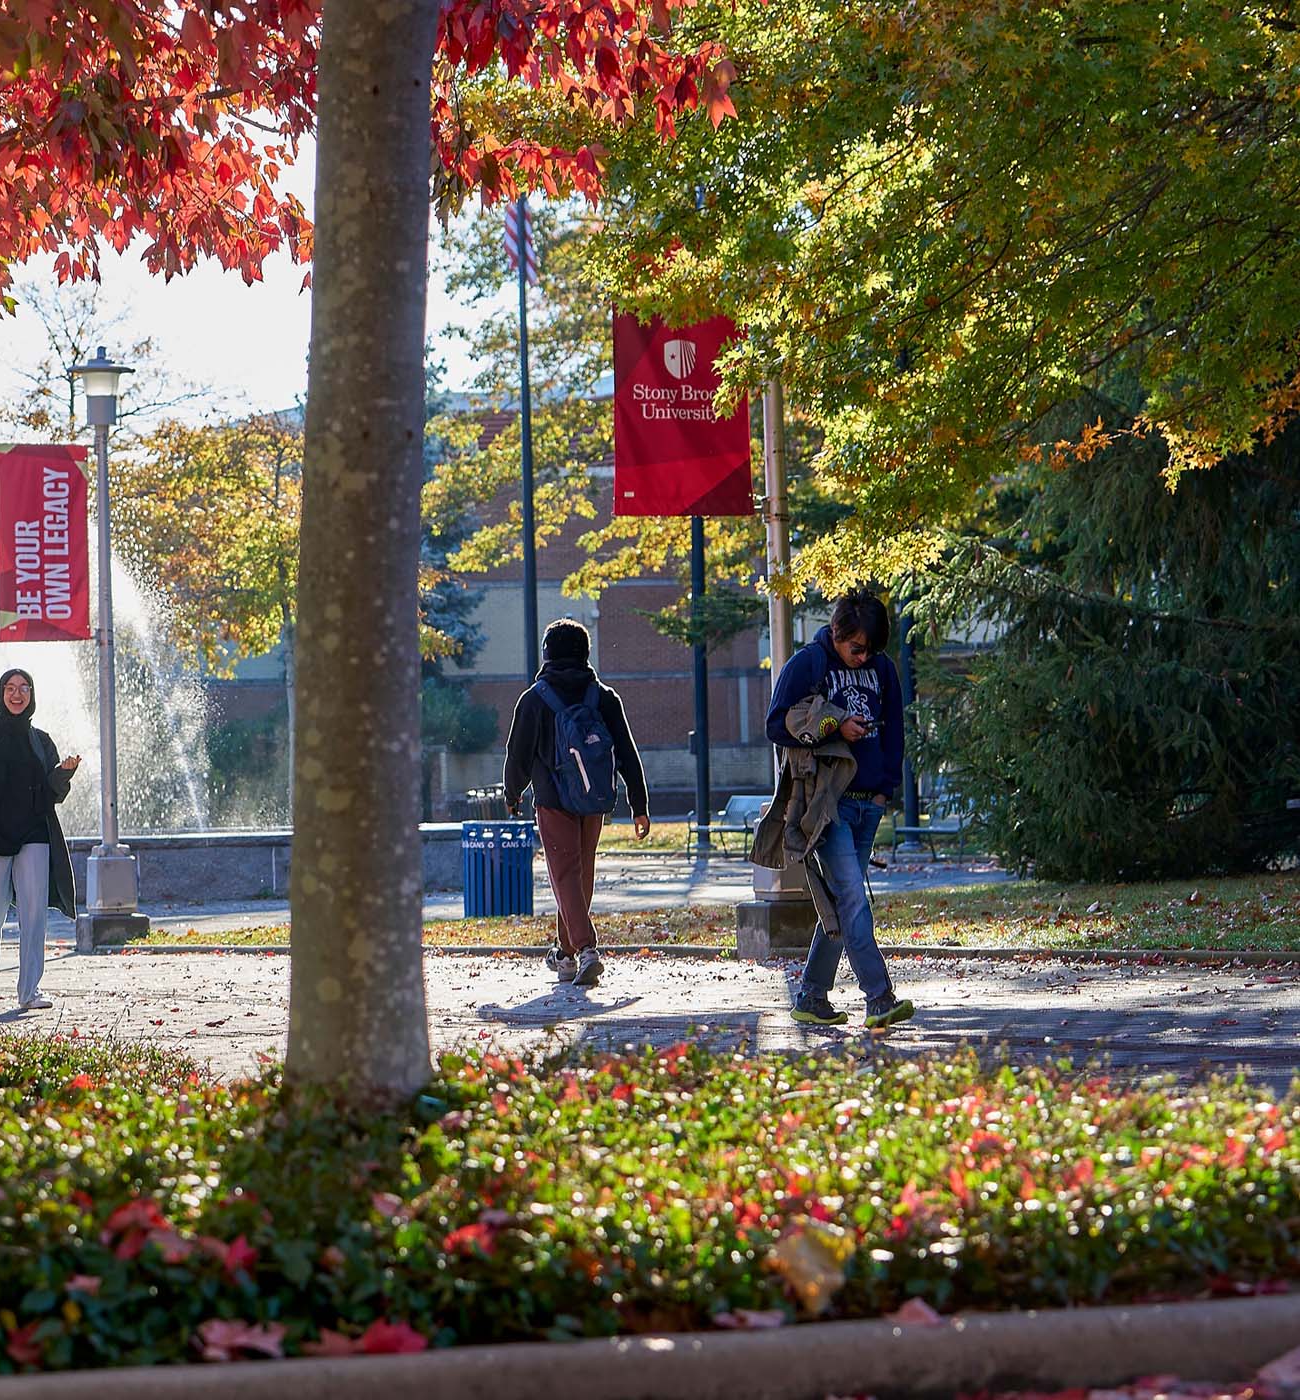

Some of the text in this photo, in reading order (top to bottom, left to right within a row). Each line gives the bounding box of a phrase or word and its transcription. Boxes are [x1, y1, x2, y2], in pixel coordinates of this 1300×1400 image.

[633, 384, 716, 404] Stony Broo
[641, 403, 718, 424] University
[43, 467, 72, 620] OWN LEGACY
[15, 520, 42, 620] BE YOUR
[469, 841, 485, 849] CANS
[501, 841, 519, 849] CANS
